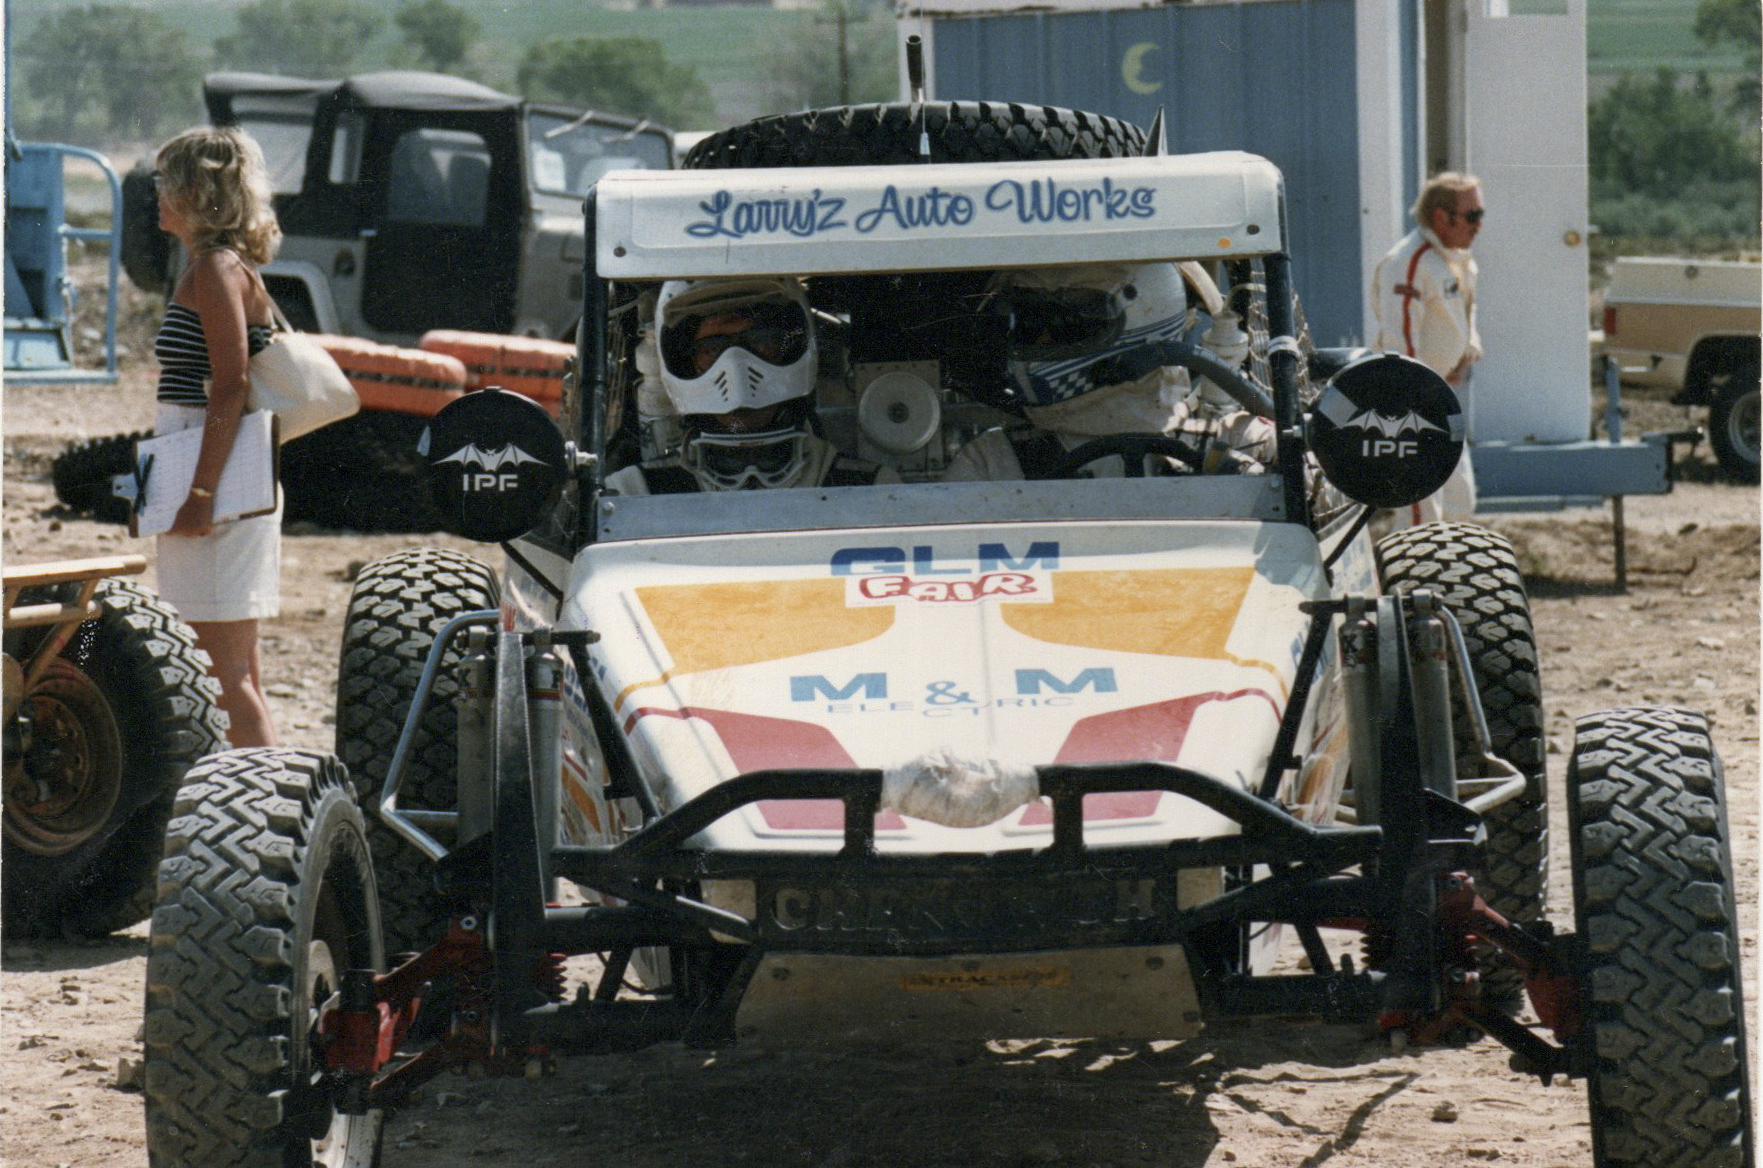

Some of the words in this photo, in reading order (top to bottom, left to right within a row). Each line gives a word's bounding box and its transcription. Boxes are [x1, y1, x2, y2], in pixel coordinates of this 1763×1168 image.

[686, 189, 847, 238] Larry'z
[856, 184, 976, 232] Auto
[985, 176, 1156, 224] Works
[1362, 439, 1418, 458] IPF
[462, 474, 518, 492] IPF
[830, 541, 1060, 576] GLM
[789, 671, 888, 702] M
[924, 680, 977, 705] &
[1015, 667, 1118, 695] M
[826, 696, 1075, 718] ELECTRIC
